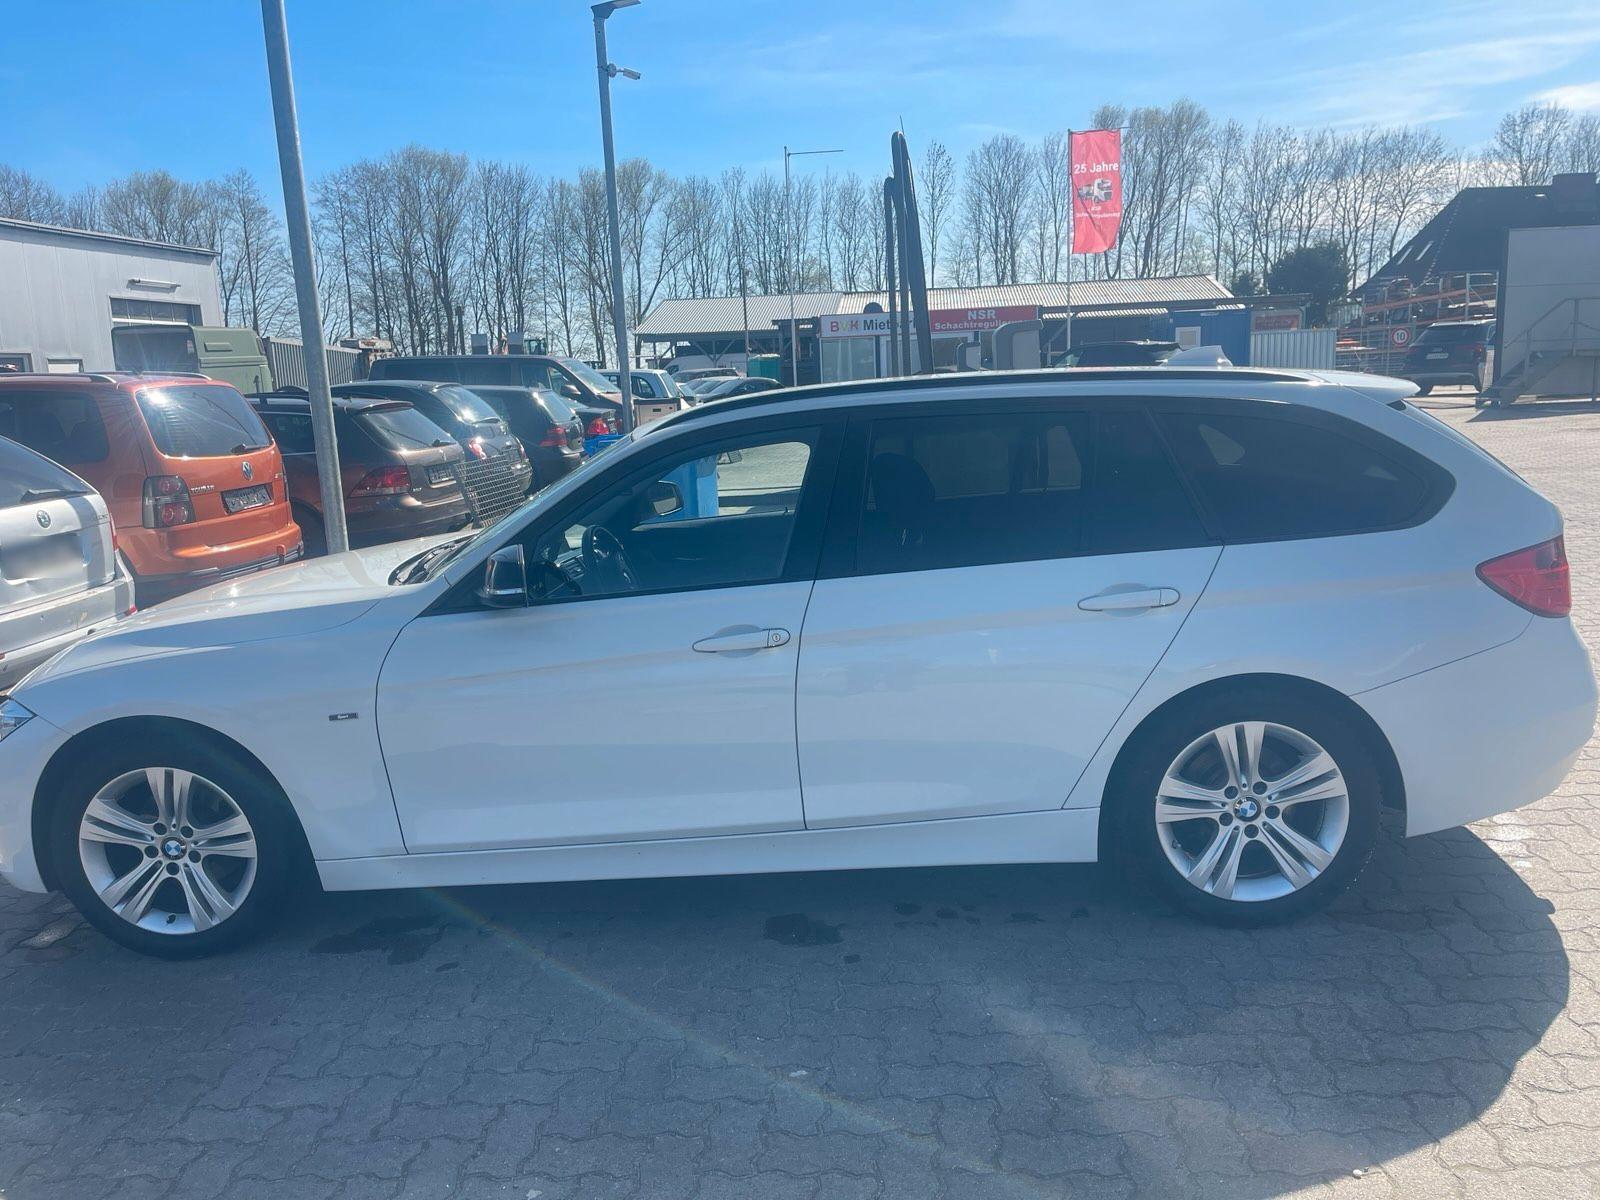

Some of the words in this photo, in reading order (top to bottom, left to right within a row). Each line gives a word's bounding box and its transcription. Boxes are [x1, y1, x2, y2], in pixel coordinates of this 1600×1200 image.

[1074, 163, 1087, 174] 25
[1090, 161, 1119, 173] Jahre
[967, 309, 996, 320] NSR
[934, 319, 1024, 331] Schachtreguli
[1396, 331, 1406, 340] 10
